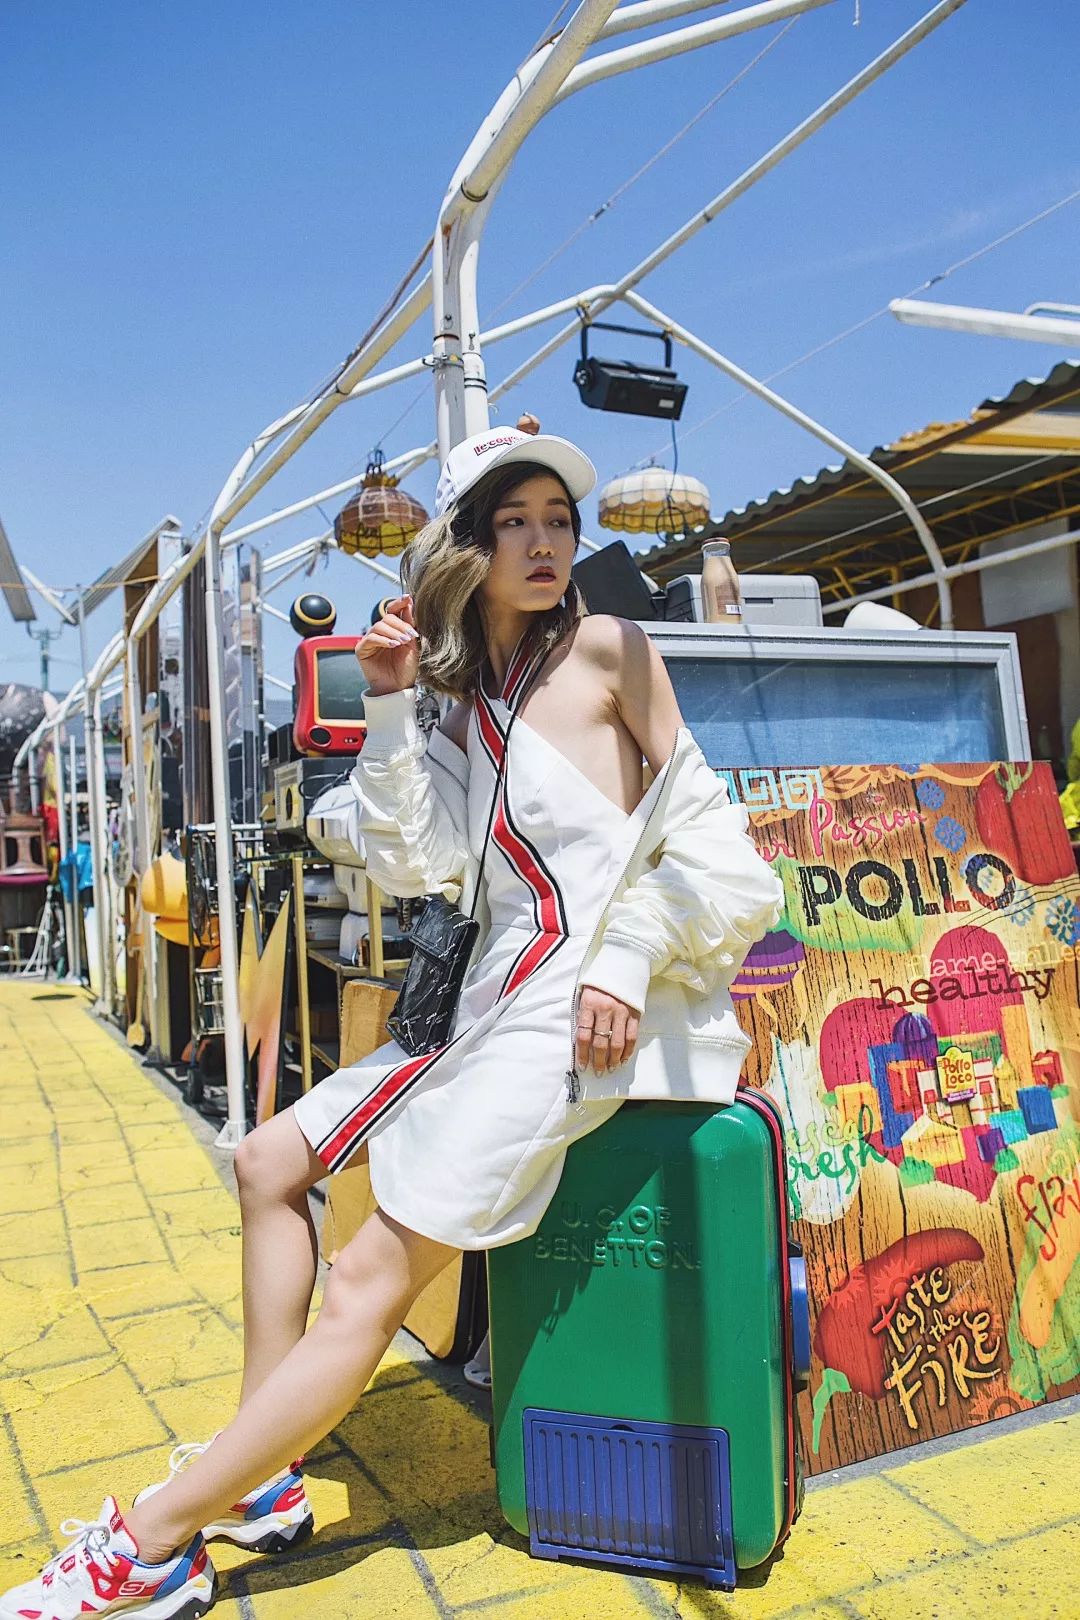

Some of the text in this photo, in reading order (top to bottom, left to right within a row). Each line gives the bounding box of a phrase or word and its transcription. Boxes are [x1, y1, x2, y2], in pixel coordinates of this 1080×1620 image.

[755, 790, 927, 862] ur Passion
[799, 853, 1017, 927] POLLO
[869, 964, 1056, 1010] healthy
[945, 1073, 973, 1089] Loco
[929, 1308, 961, 1342] the
